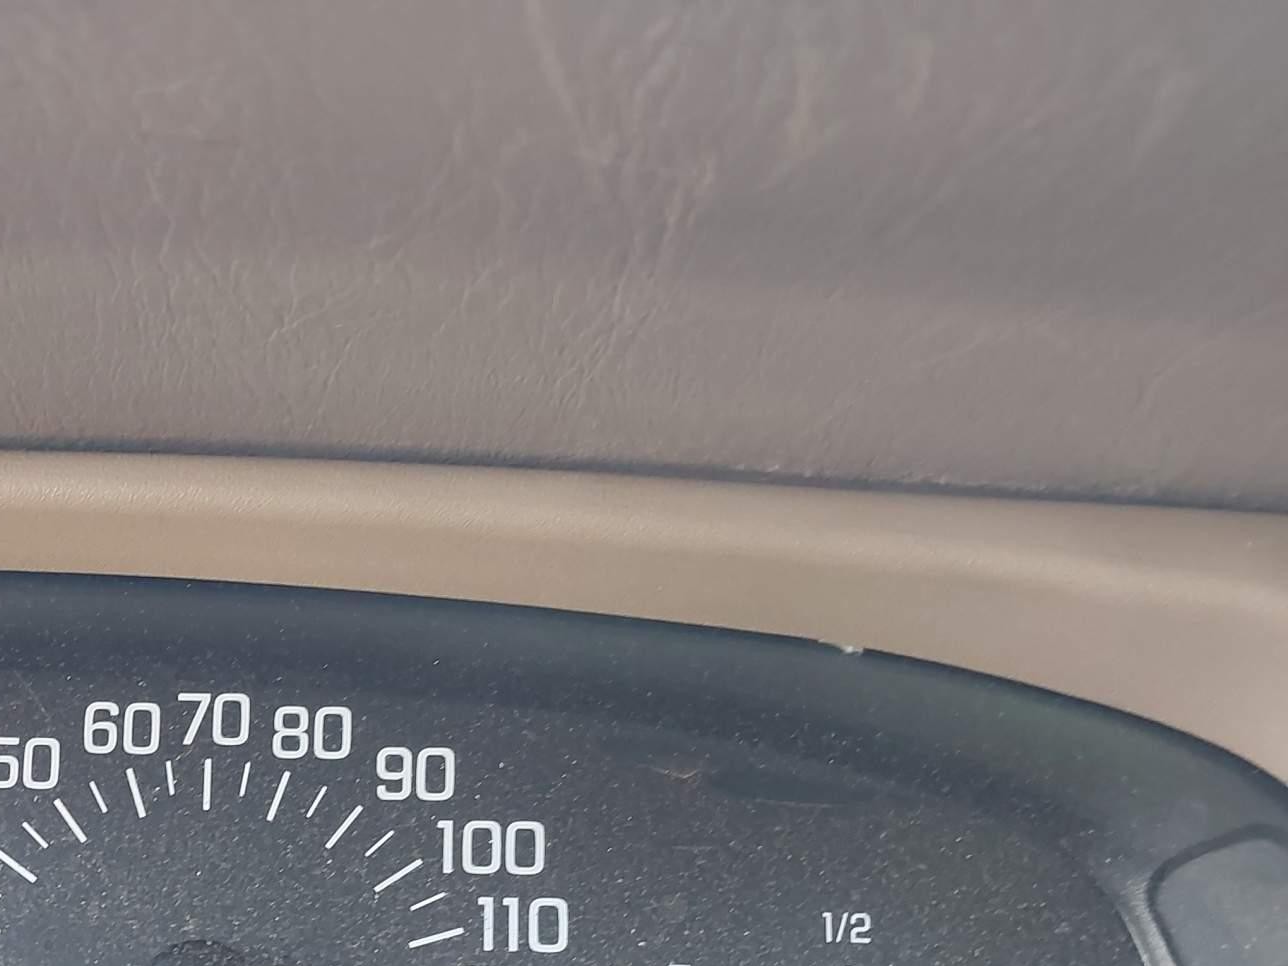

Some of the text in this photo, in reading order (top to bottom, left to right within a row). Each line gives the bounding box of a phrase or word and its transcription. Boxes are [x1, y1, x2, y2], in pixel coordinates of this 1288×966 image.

[84, 702, 160, 754] 60
[177, 693, 249, 746] 70
[273, 706, 351, 759] 80
[377, 748, 454, 801] 90
[438, 820, 545, 875] 100
[479, 897, 568, 953] 110
[823, 913, 871, 944] 1/2
